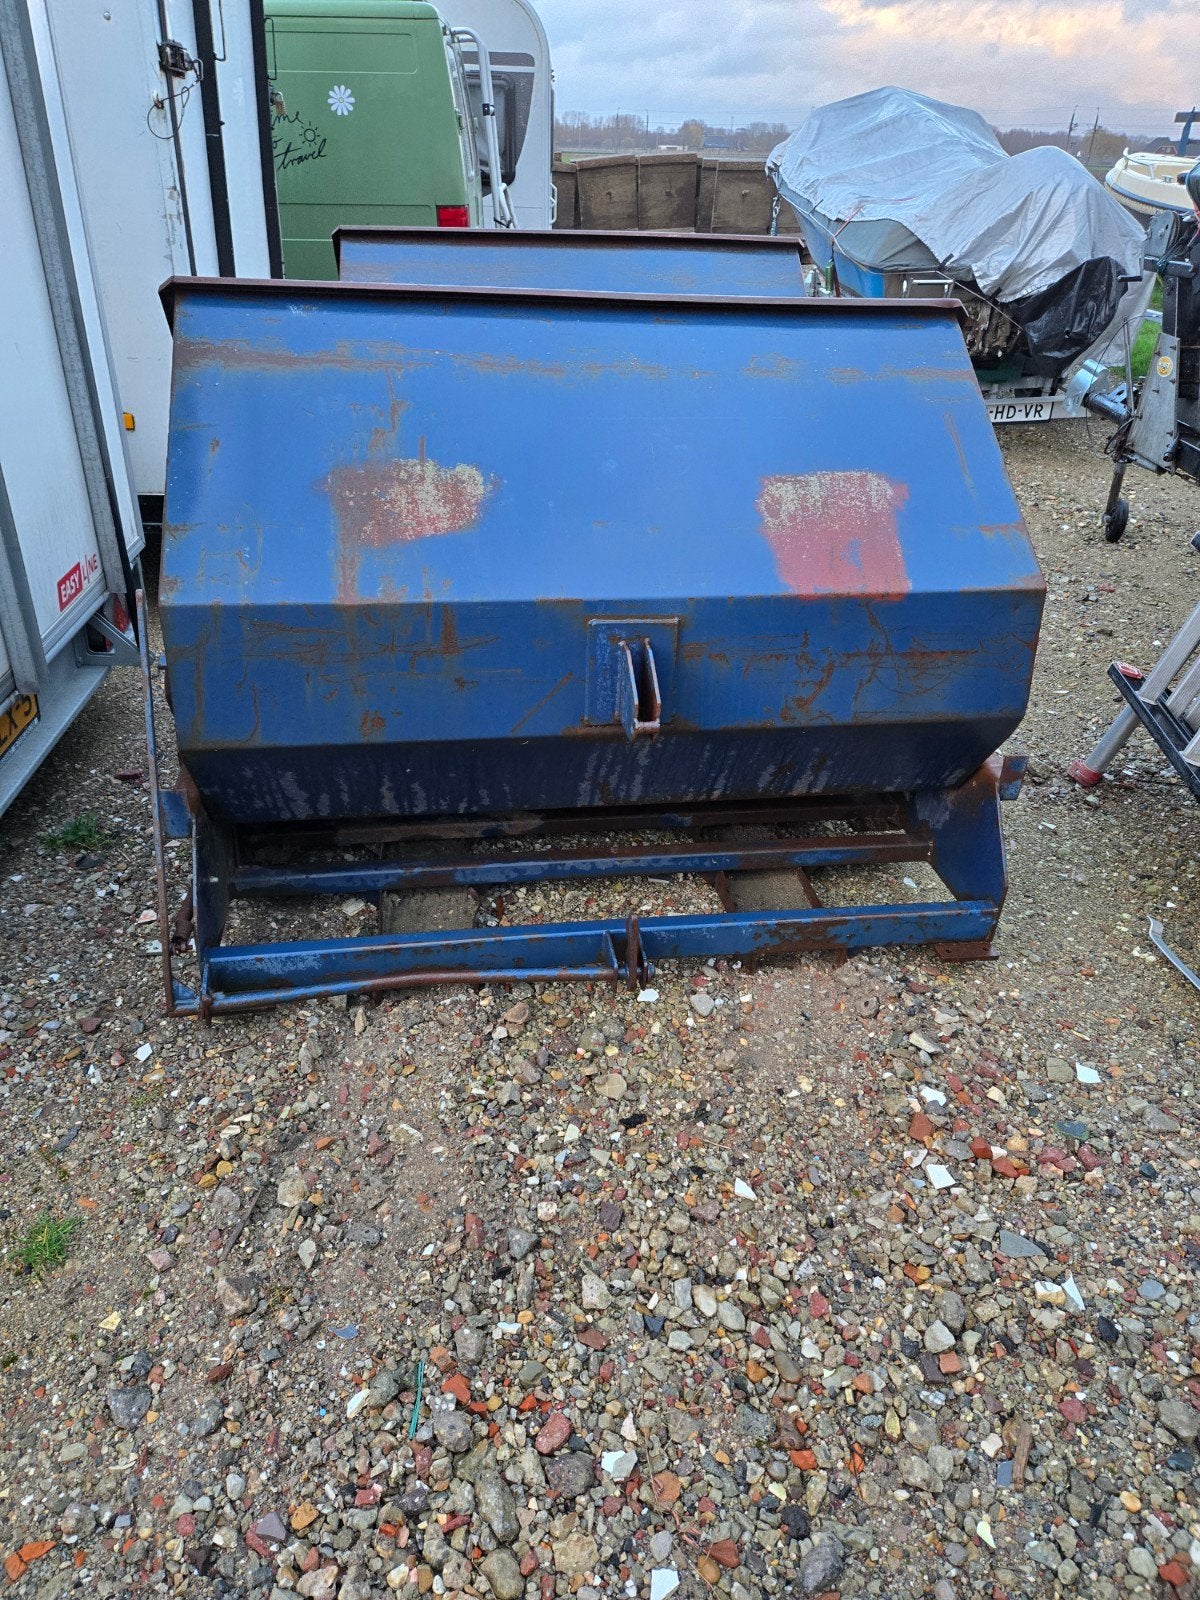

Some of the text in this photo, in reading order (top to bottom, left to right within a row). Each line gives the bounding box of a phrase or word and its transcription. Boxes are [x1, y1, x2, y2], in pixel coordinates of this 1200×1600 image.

[274, 138, 327, 171] travel
[60, 553, 98, 603] EASY LINE
